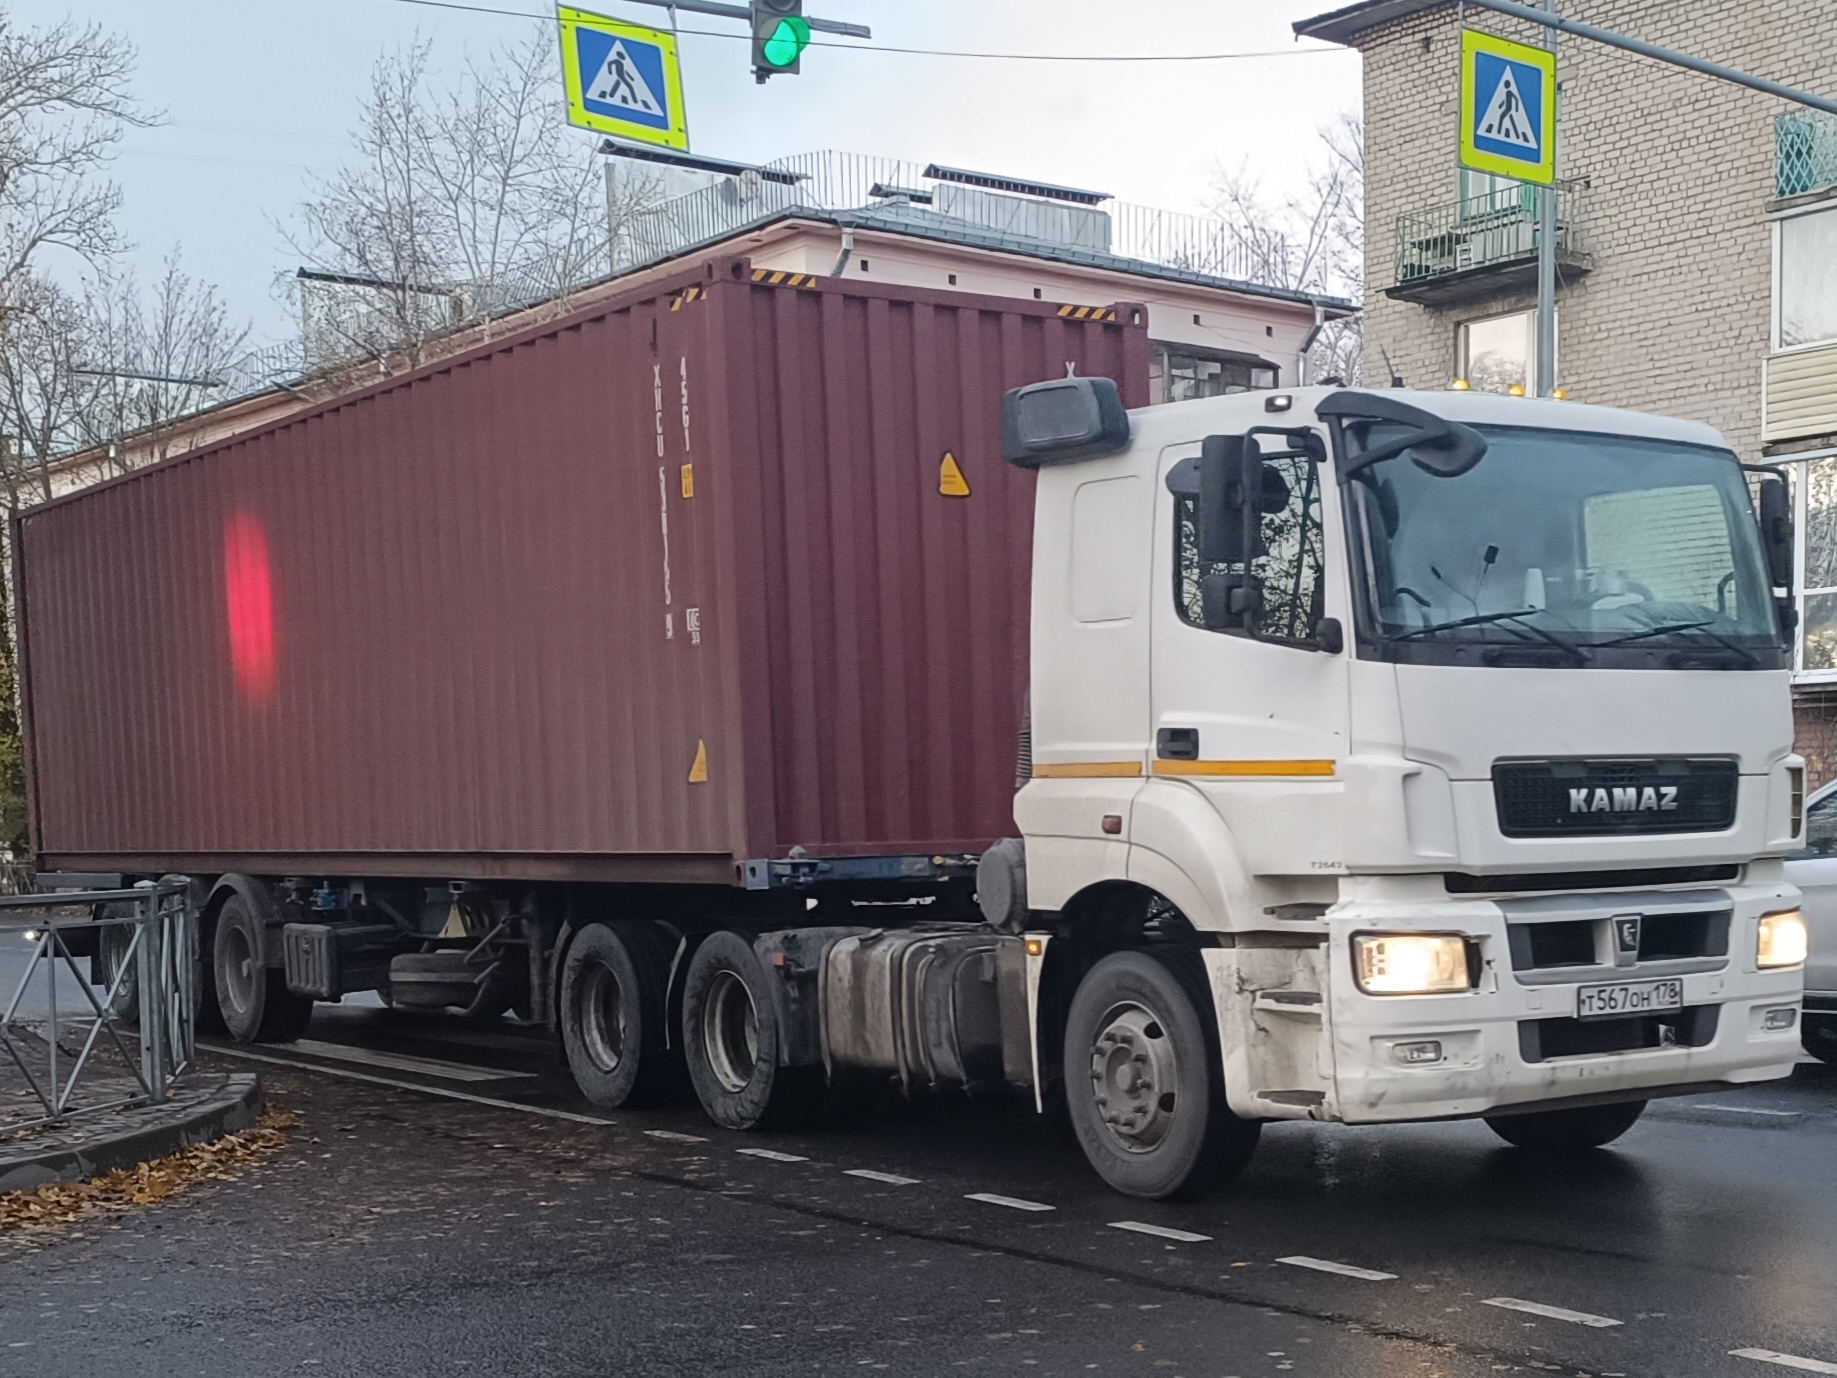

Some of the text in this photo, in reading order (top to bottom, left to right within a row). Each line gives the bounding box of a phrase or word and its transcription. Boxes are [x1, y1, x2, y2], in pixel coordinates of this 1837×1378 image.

[680, 356, 690, 452] 45G1
[1568, 786, 1678, 813] KAMAZ
[1654, 982, 1679, 1000] 178
